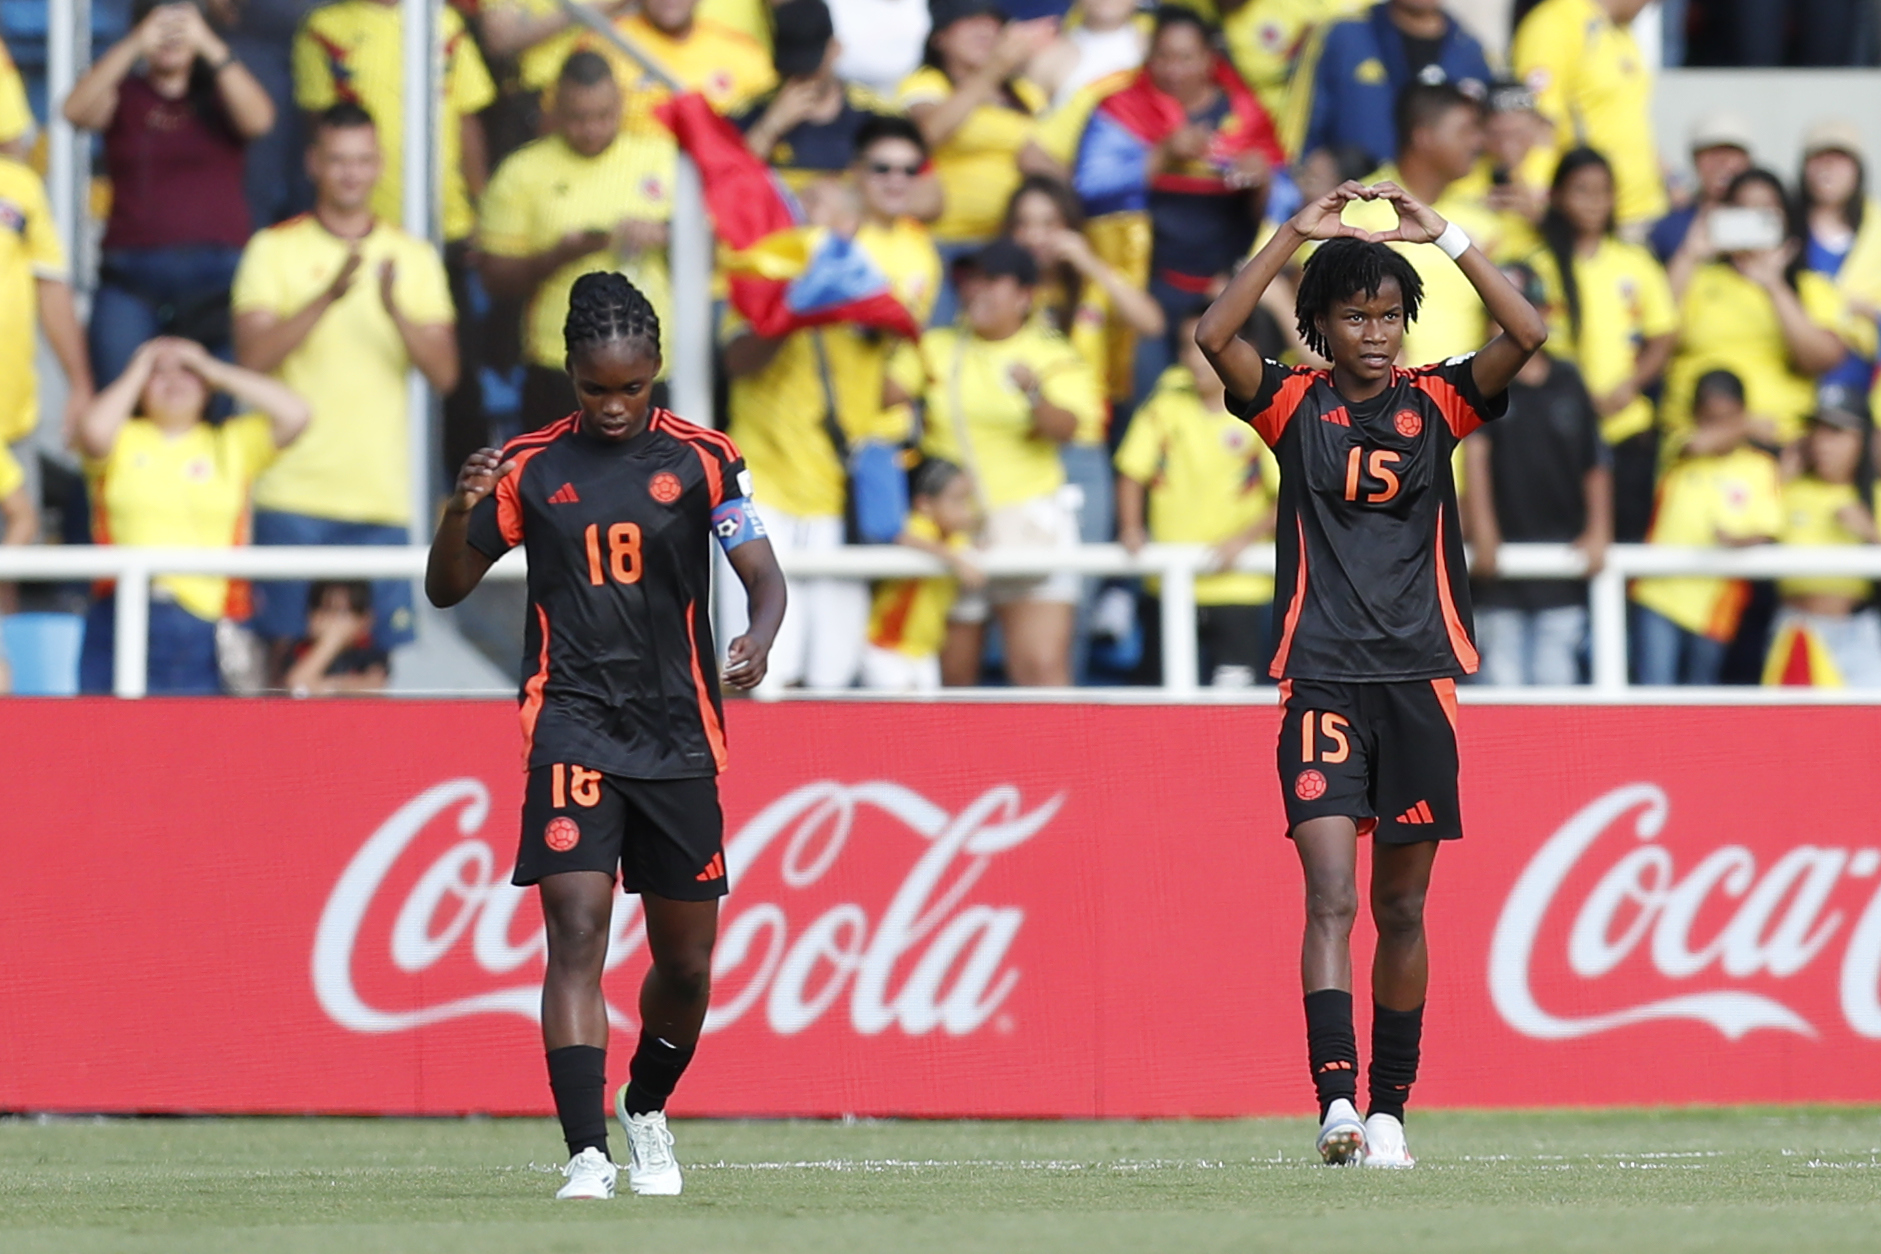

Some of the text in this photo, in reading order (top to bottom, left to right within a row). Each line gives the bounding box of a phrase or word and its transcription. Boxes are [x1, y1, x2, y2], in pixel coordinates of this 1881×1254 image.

[1344, 446, 1402, 503] 15
[584, 522, 643, 586] 18
[1301, 710, 1351, 764] 15
[1487, 781, 1881, 1042] Coca-
